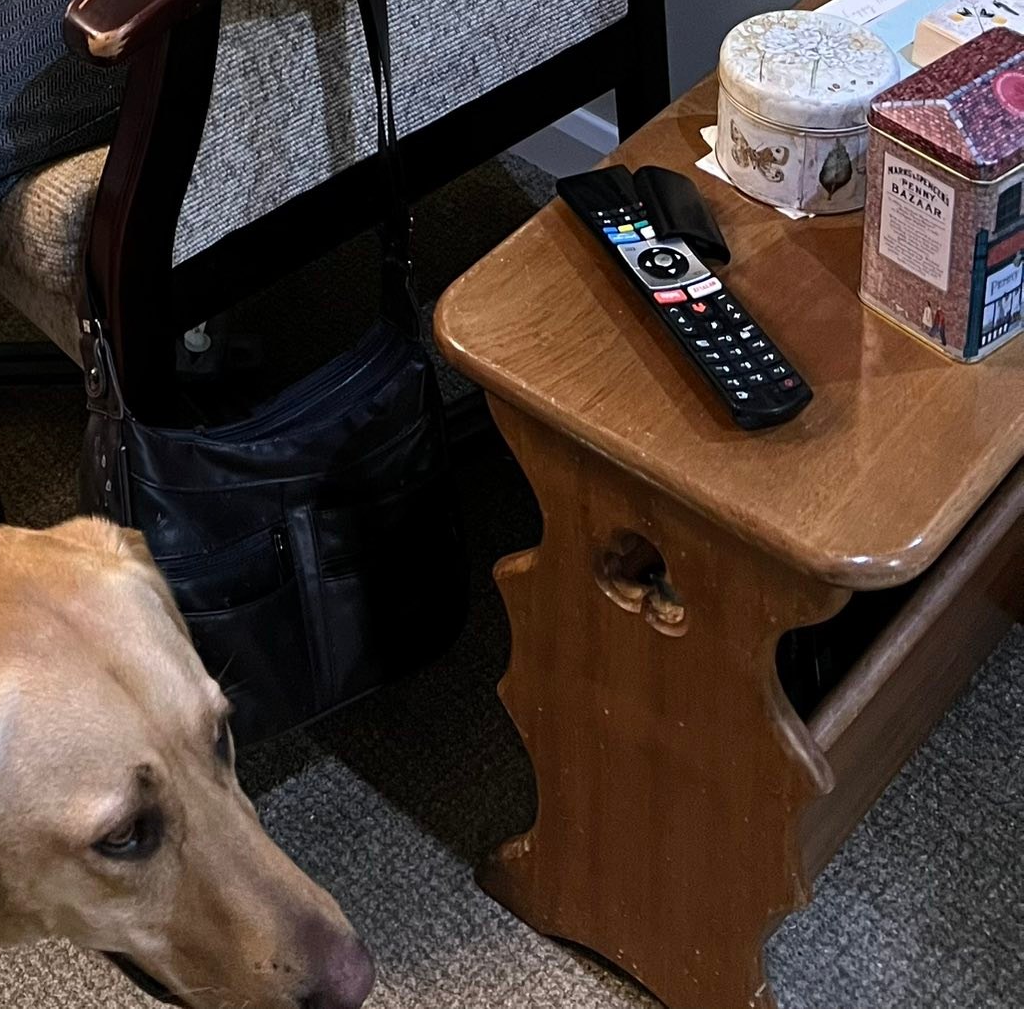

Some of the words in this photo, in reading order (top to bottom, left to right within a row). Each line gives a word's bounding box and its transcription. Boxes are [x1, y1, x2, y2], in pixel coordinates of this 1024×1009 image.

[887, 166, 913, 178] MARKS
[892, 182, 942, 219] BAZAAR
[901, 178, 936, 202] PENNY
